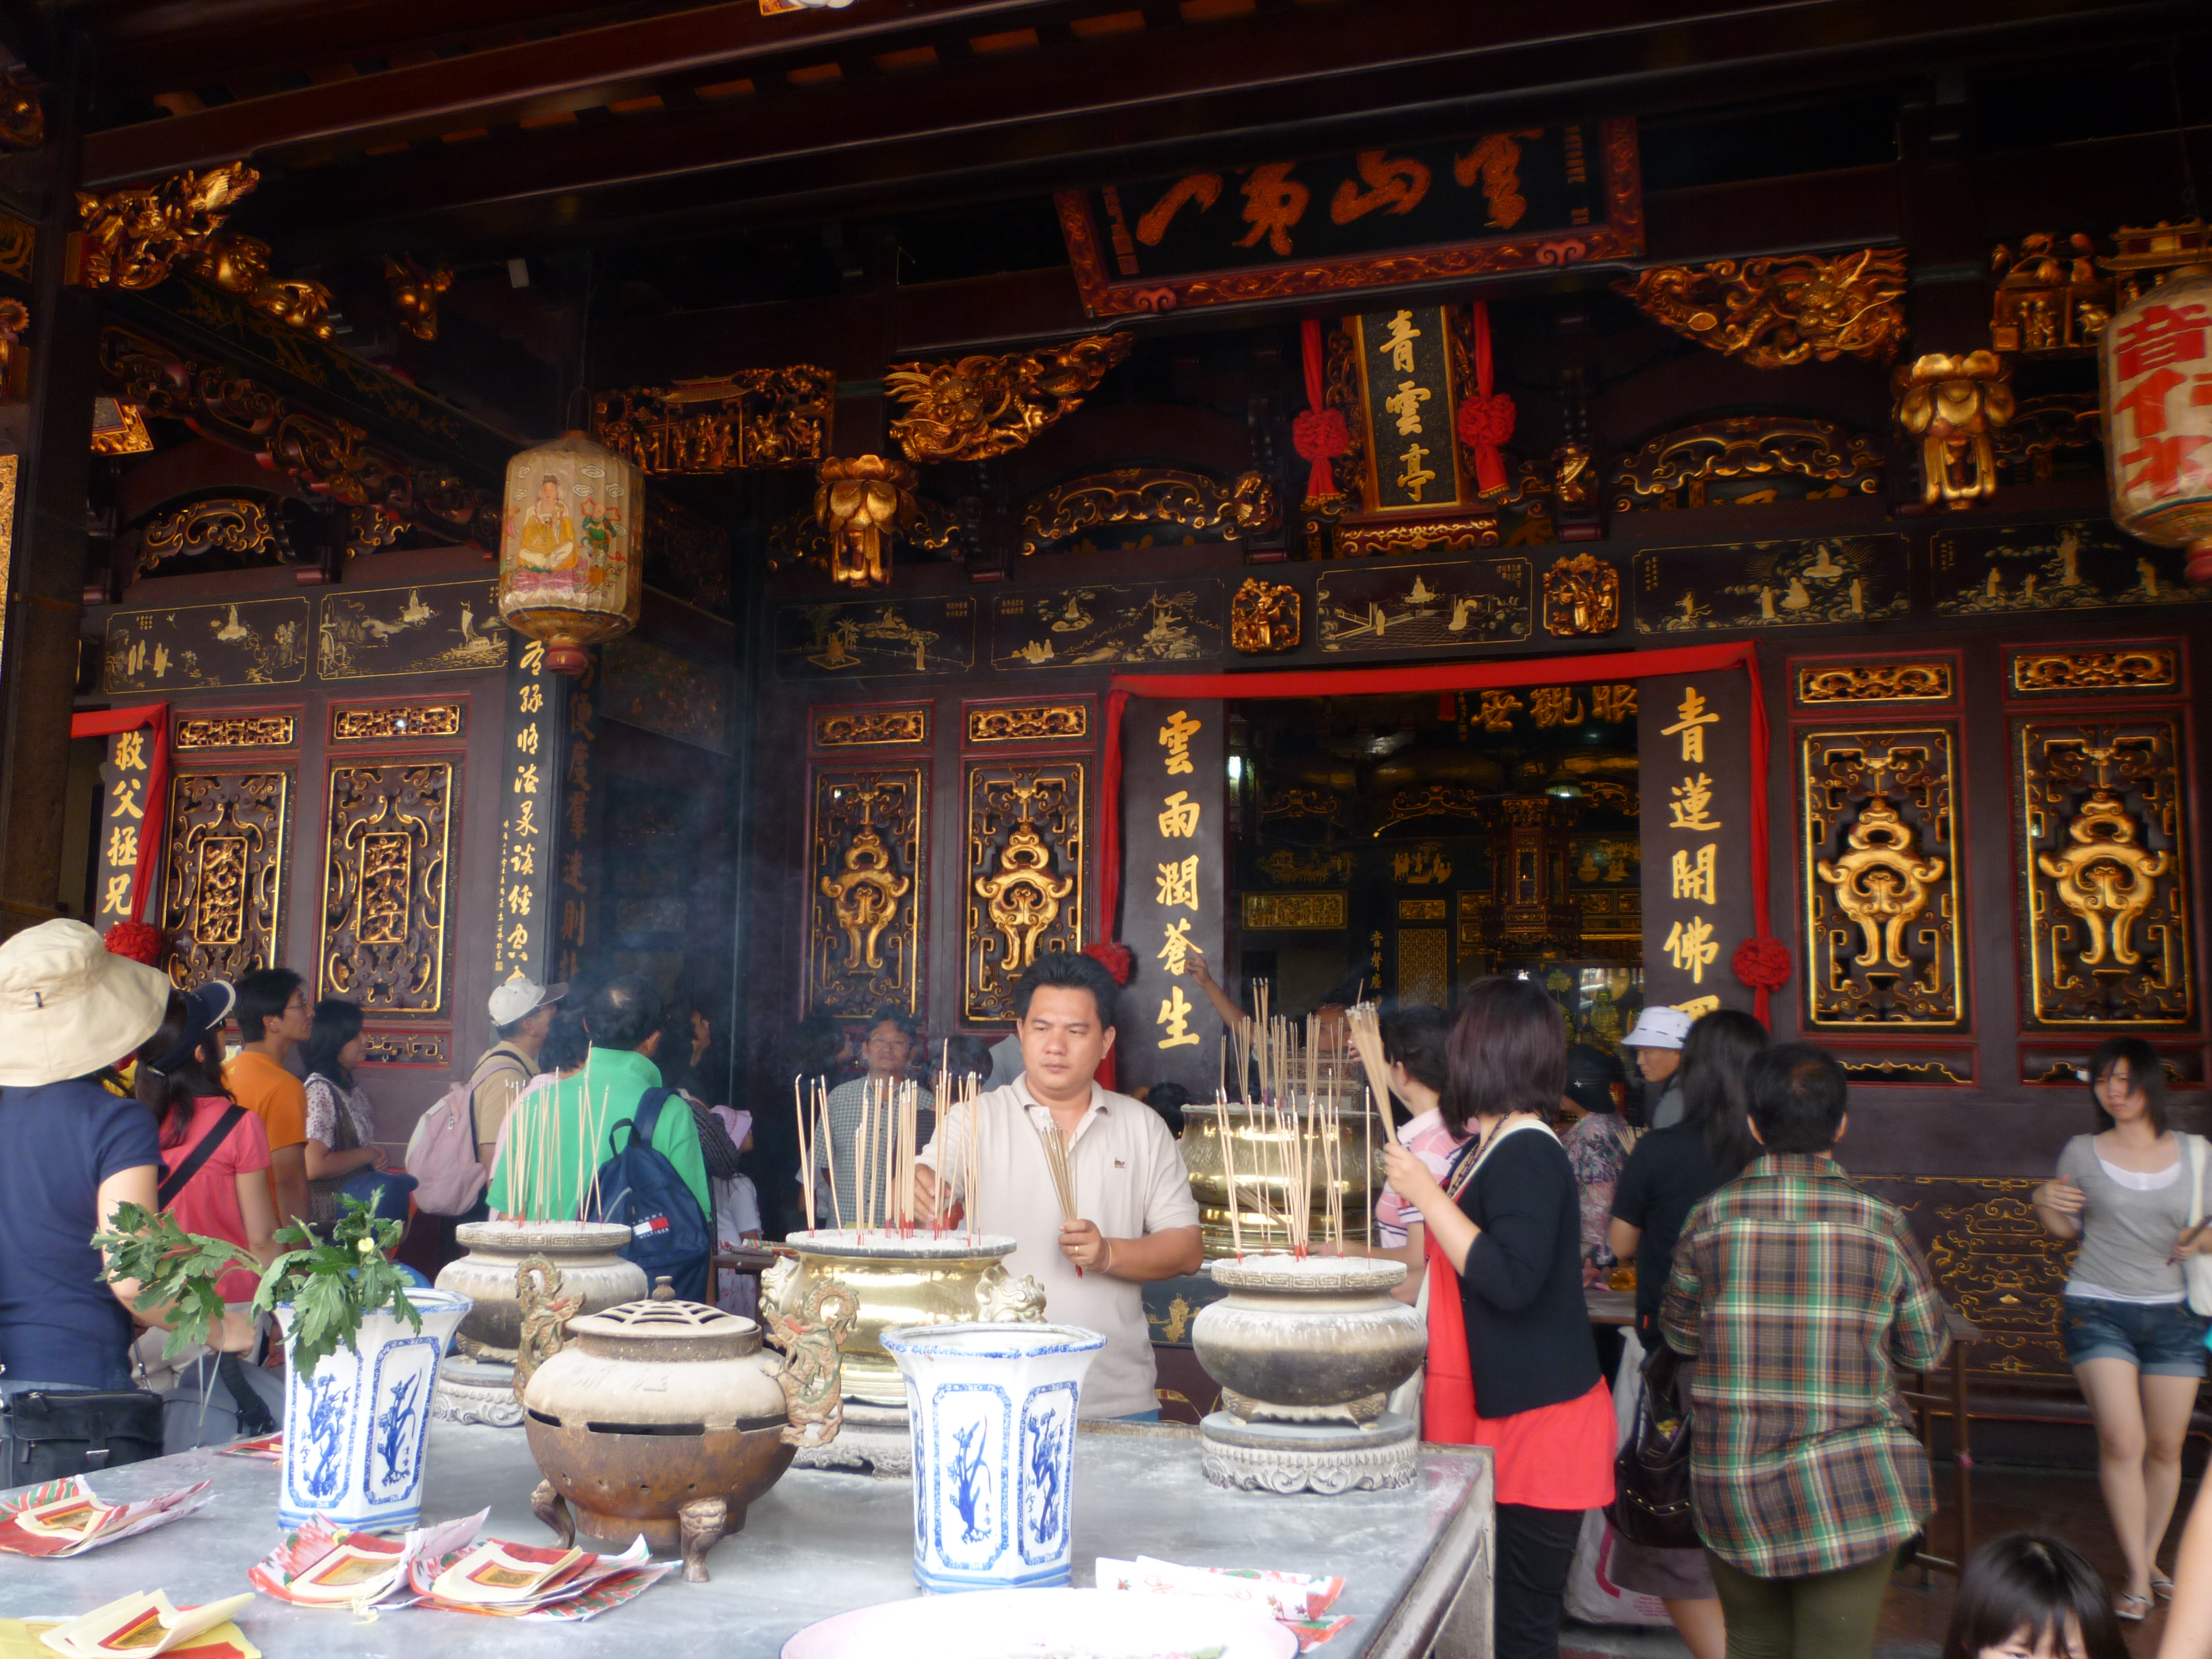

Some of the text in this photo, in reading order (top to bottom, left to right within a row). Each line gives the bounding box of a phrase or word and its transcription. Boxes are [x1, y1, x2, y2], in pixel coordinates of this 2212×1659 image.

[1380, 309, 1436, 502] 青雲亭
[102, 730, 147, 927] 救父拯兄
[1155, 710, 1204, 1050] 雲雨潤蒼生
[632, 1212, 663, 1225] TOMMY
[638, 1227, 670, 1240] HILFIGER
